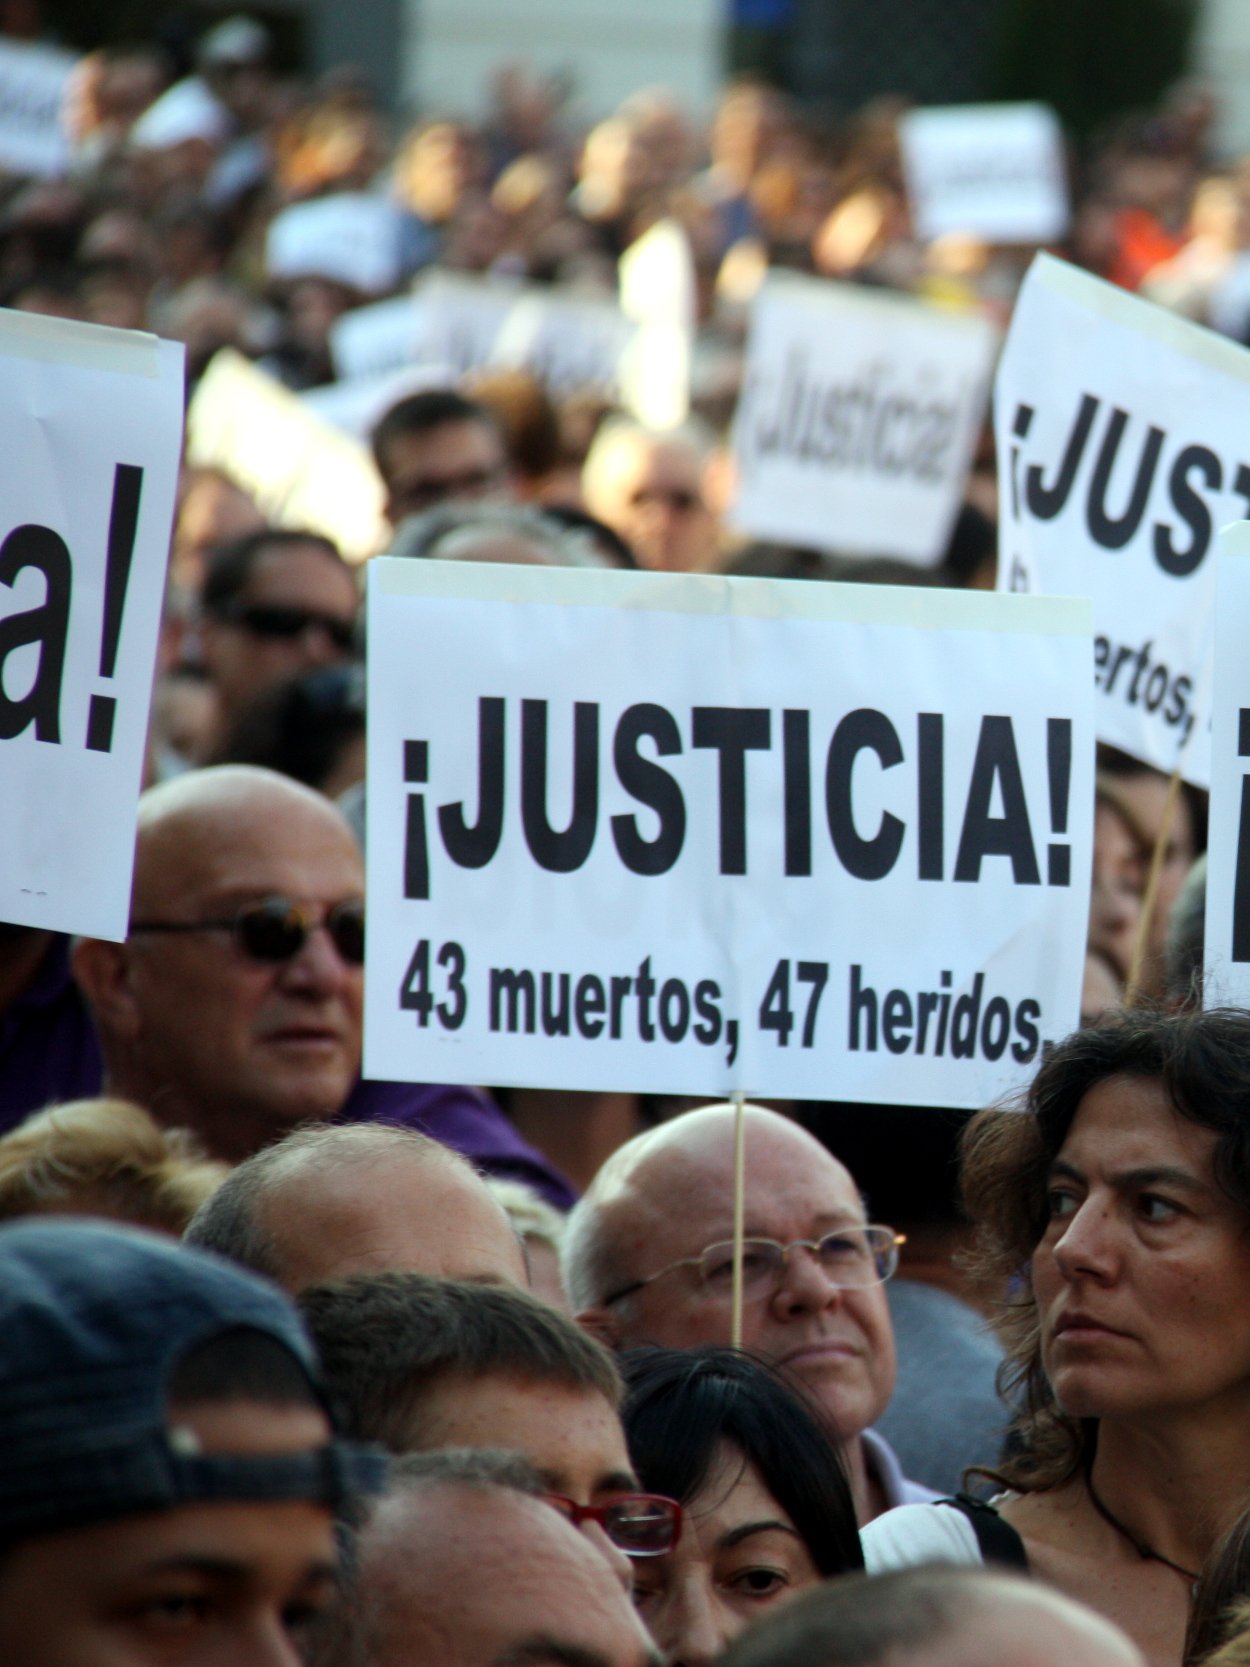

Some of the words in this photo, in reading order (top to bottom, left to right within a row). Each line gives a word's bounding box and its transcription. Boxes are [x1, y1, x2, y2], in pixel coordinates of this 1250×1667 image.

[402, 696, 1073, 900] ¡JUSTICIA!
[400, 939, 467, 1031] 43
[489, 956, 741, 1067] muertos,
[759, 959, 830, 1049] 47
